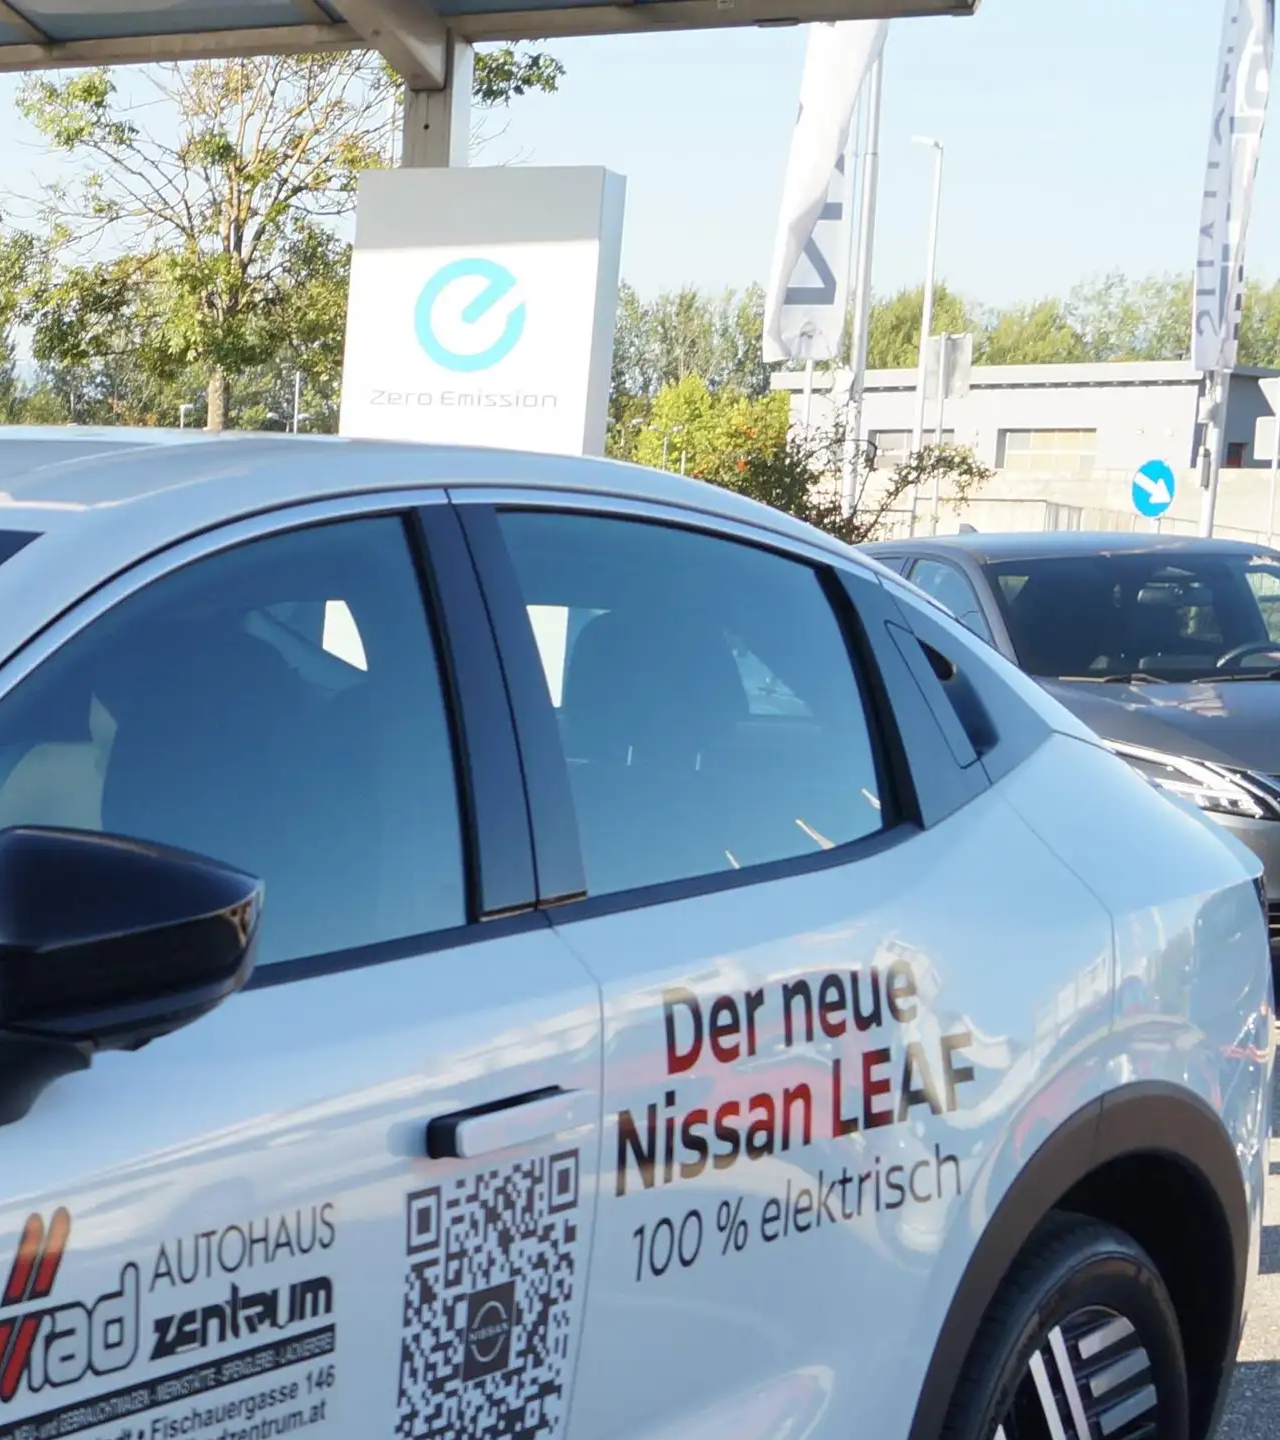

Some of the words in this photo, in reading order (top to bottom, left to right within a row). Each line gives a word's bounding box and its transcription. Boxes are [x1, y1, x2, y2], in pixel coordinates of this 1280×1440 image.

[370, 389, 433, 406] Zero
[441, 390, 558, 408] Emission
[662, 986, 765, 1076] Der
[782, 960, 919, 1047] neue
[616, 1082, 813, 1198] Nissan
[831, 1030, 975, 1139] LEAF
[149, 1202, 335, 1292] AUTOHAUS
[633, 1209, 703, 1282] 100
[716, 1196, 749, 1256] %
[760, 1143, 962, 1243] elektrisch
[305, 1363, 336, 1395] 146
